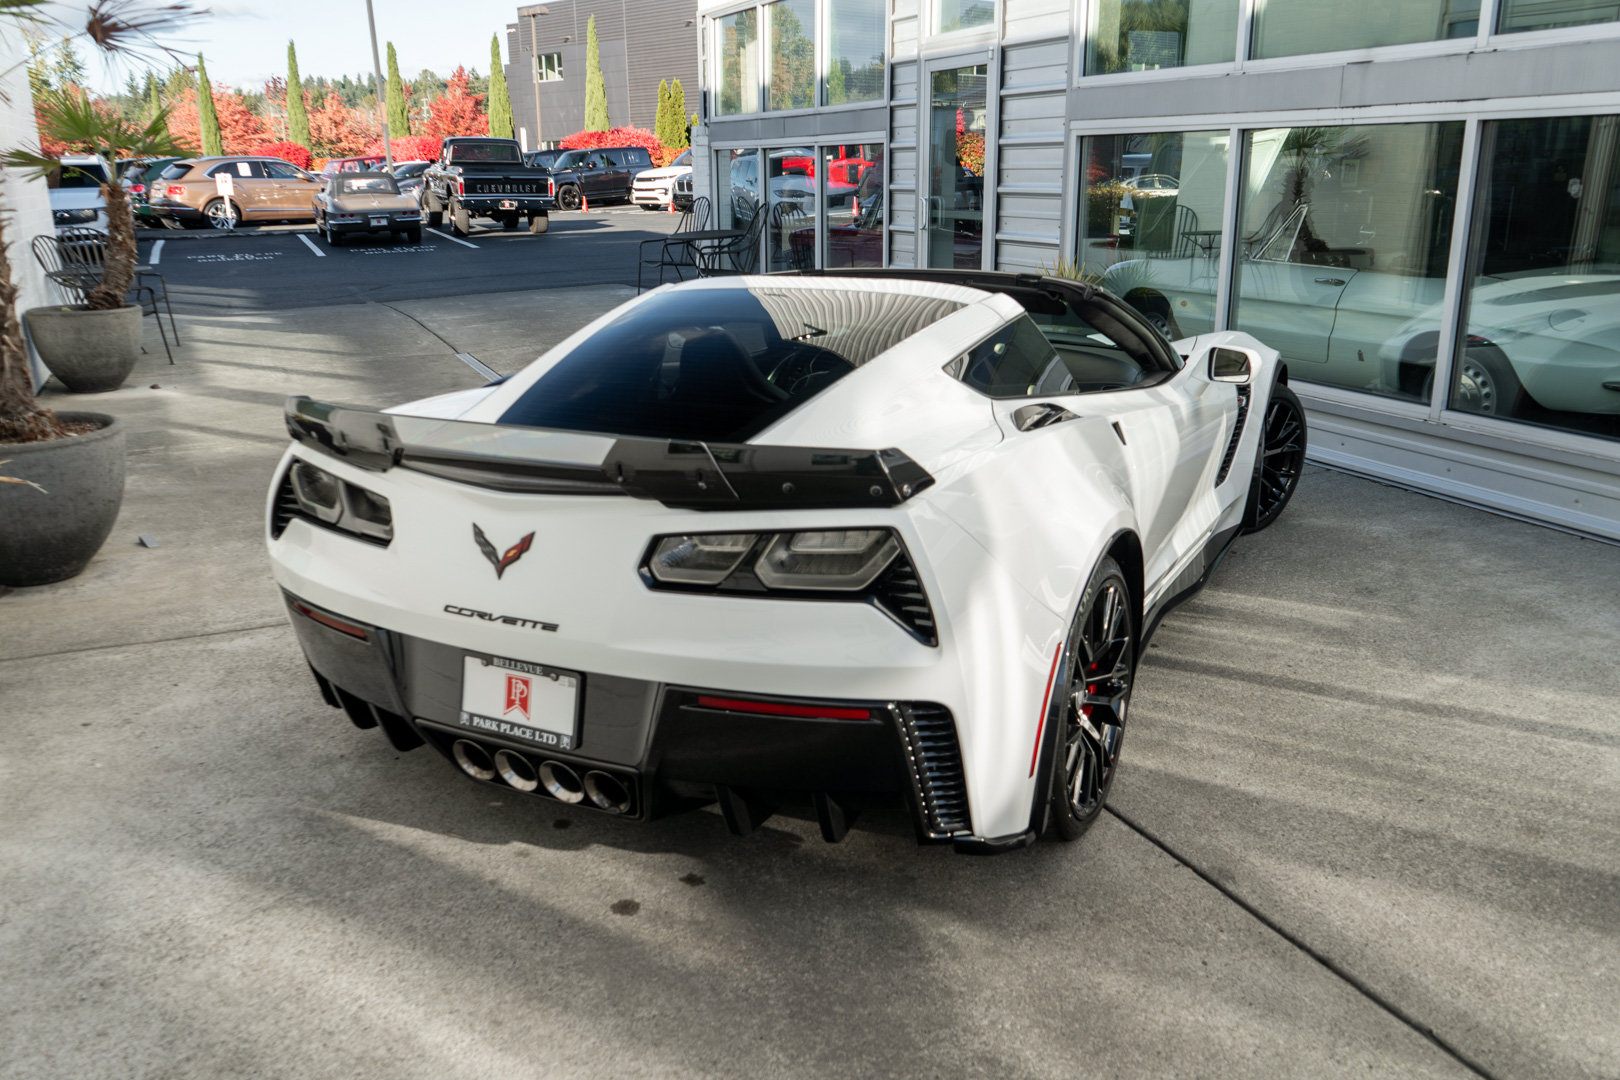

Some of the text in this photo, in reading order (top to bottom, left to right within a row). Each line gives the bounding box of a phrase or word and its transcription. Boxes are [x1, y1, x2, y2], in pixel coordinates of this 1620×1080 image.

[476, 184, 537, 193] CHEVROLET
[444, 604, 559, 632] CORVETTE
[493, 657, 543, 675] BELLEVUE
[473, 716, 557, 745] PARK PLACE LTD
